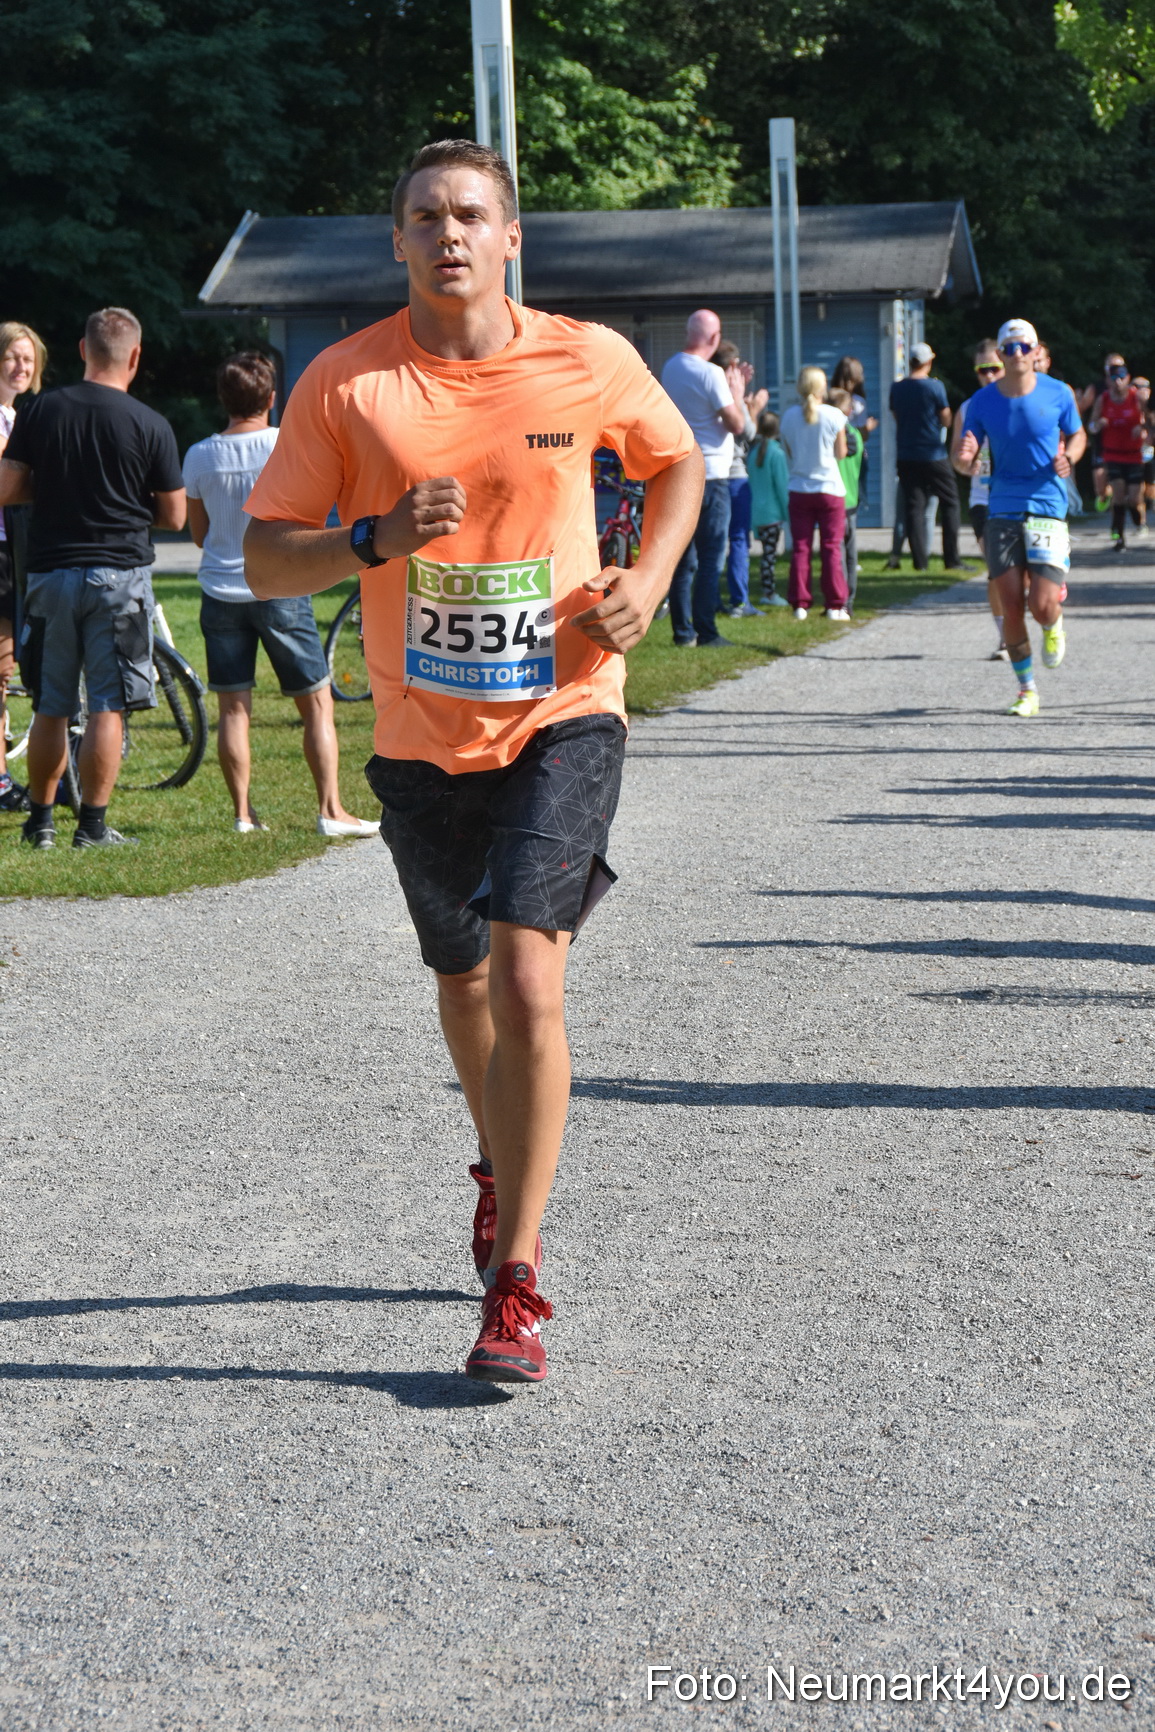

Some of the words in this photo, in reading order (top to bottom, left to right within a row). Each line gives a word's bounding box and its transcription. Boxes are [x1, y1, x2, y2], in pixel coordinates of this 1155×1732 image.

[525, 433, 574, 449] THULE
[1032, 533, 1051, 548] 21
[417, 562, 541, 600] BOCK
[420, 606, 538, 654] 2534
[418, 657, 539, 684] CHRISTOPH
